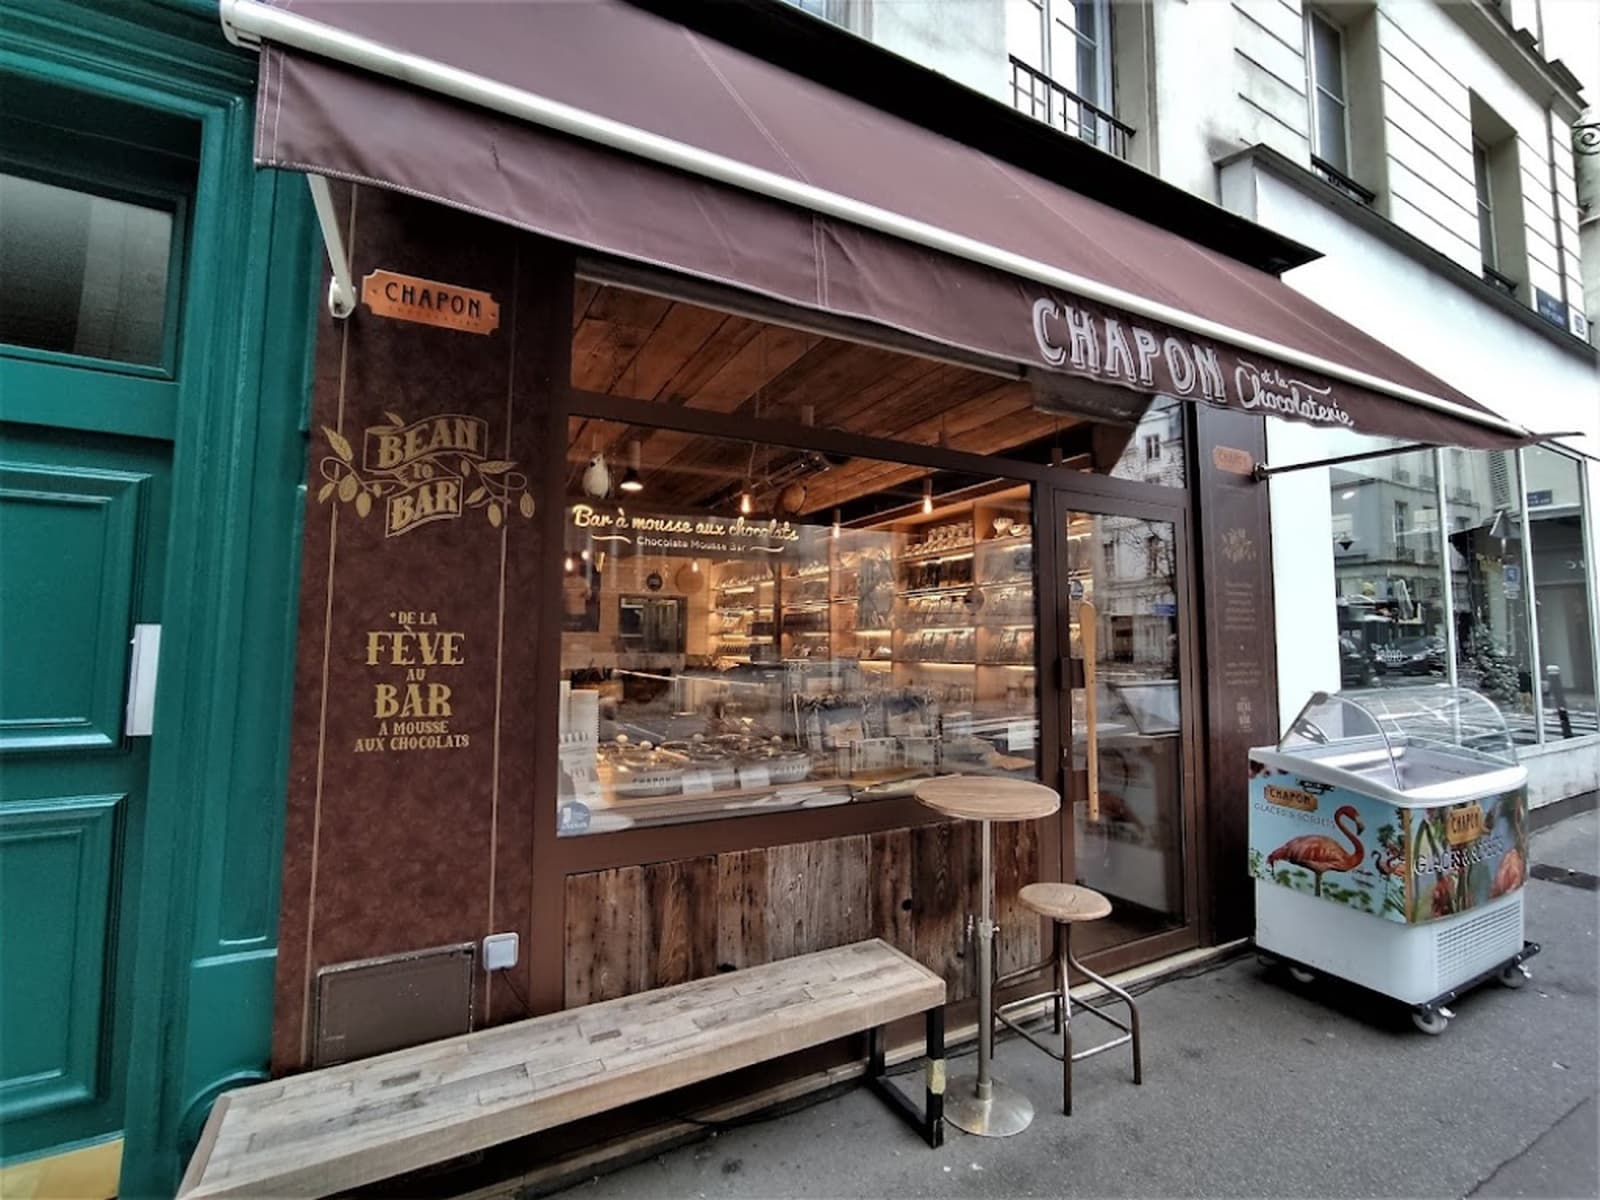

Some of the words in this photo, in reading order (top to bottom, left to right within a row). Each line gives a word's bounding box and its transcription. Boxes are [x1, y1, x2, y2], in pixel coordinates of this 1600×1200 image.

[385, 282, 481, 318] CHAPON
[1032, 297, 1227, 403] CHAPON
[1235, 366, 1355, 427] Chocolaterie
[378, 418, 479, 470] BEAN
[389, 480, 459, 531] BAR
[572, 504, 613, 528] Bar
[615, 507, 629, 529] à
[631, 516, 694, 534] mousse
[694, 522, 726, 537] aux
[728, 515, 800, 542] chocolats
[636, 534, 689, 549] Chocolate
[690, 539, 727, 552] Mousse
[419, 611, 439, 625] LA
[364, 624, 466, 666] FÈVE
[406, 668, 427, 682] AU
[373, 682, 452, 719] BAR
[353, 737, 386, 753] AUX
[389, 733, 471, 751] CHOCOLATS
[392, 720, 449, 736] MOUSSE
